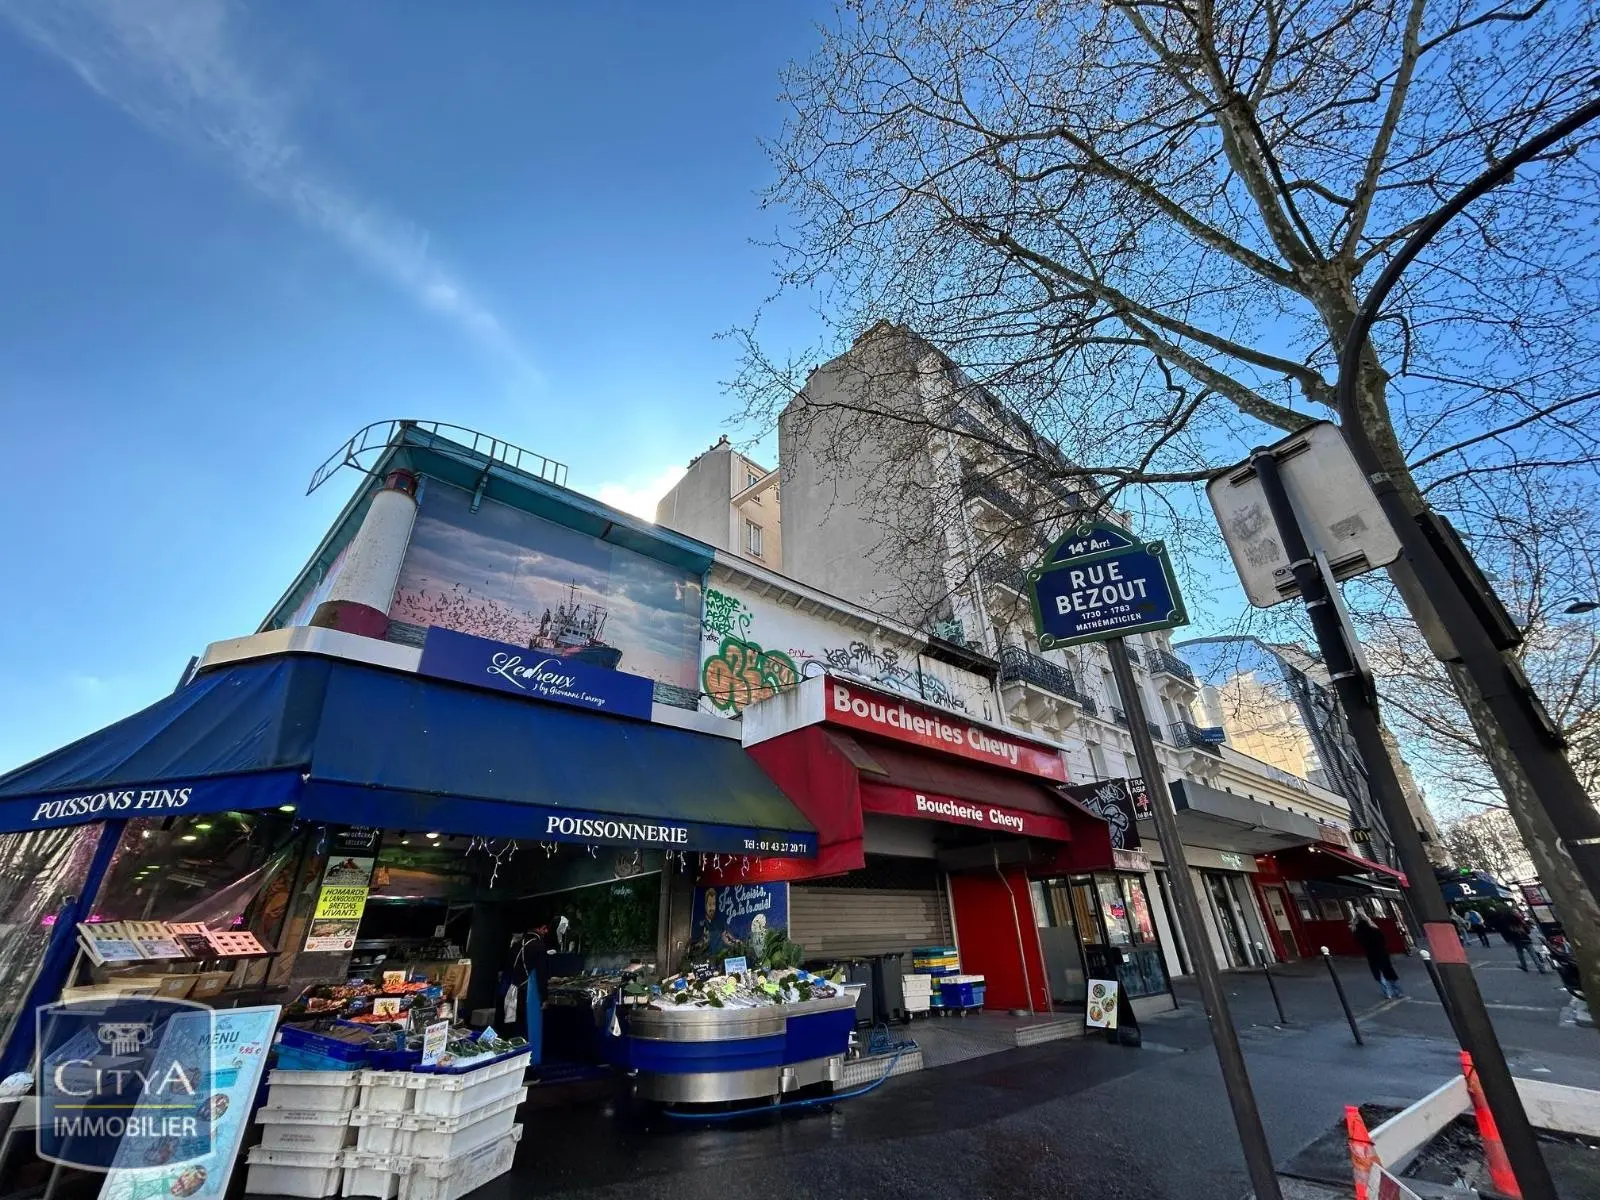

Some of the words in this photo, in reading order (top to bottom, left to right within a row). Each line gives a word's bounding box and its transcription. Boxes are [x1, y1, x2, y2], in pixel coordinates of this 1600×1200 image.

[1070, 561, 1124, 589] RUE
[1055, 578, 1147, 615] BEZOUT
[1075, 612, 1142, 631] MATHÉMATICIEN
[1081, 610, 1101, 620] 1730
[1110, 604, 1131, 613] 1783
[486, 652, 576, 690] Ledreux
[549, 686, 580, 699] Giovanni
[833, 684, 963, 745] Boucheries
[966, 726, 1019, 766] Chevy
[32, 790, 134, 821] POISSONS
[133, 787, 192, 809] FINS
[915, 794, 984, 822] Boucherie
[989, 808, 1024, 832] Chevy
[546, 816, 689, 844] POISSONNERIE
[760, 841, 769, 850] 01
[770, 842, 780, 851] 43
[780, 843, 789, 852] 27
[789, 843, 798, 852] 20
[798, 844, 807, 853] 71
[325, 888, 366, 896] HOMARDS
[328, 895, 365, 903] LANGOUSTES
[321, 909, 359, 917] VIVANTS
[198, 1030, 240, 1045] MENU
